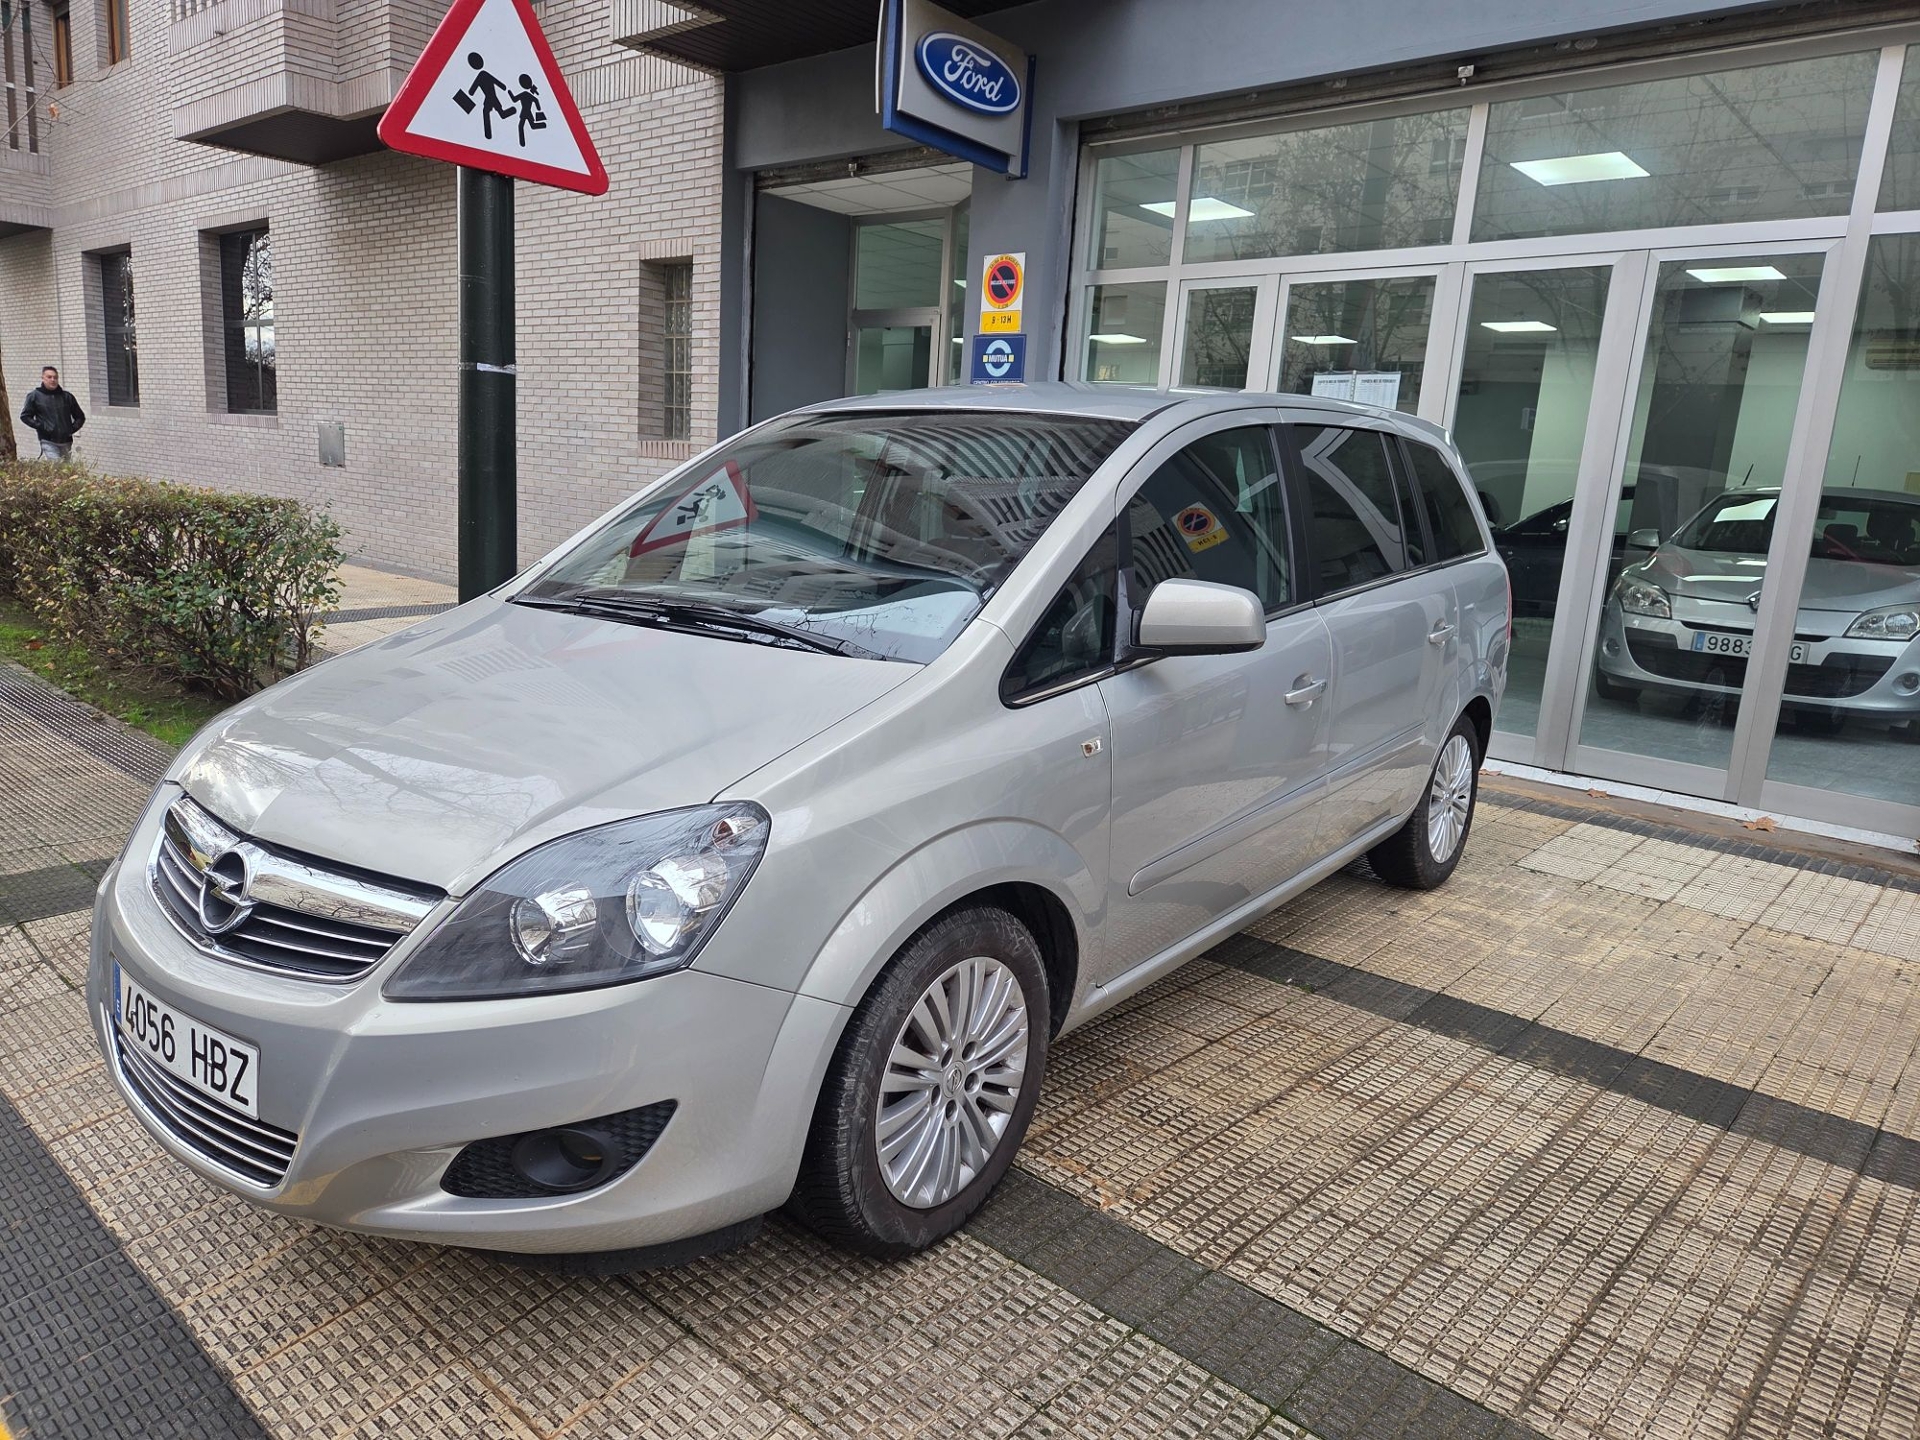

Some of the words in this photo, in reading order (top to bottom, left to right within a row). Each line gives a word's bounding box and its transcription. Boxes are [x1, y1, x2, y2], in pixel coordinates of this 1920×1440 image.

[944, 44, 1004, 102] Ford
[988, 354, 1008, 362] MUTUA
[1790, 645, 1802, 661] G
[125, 986, 176, 1063] 4056
[190, 1028, 249, 1107] HBZ
